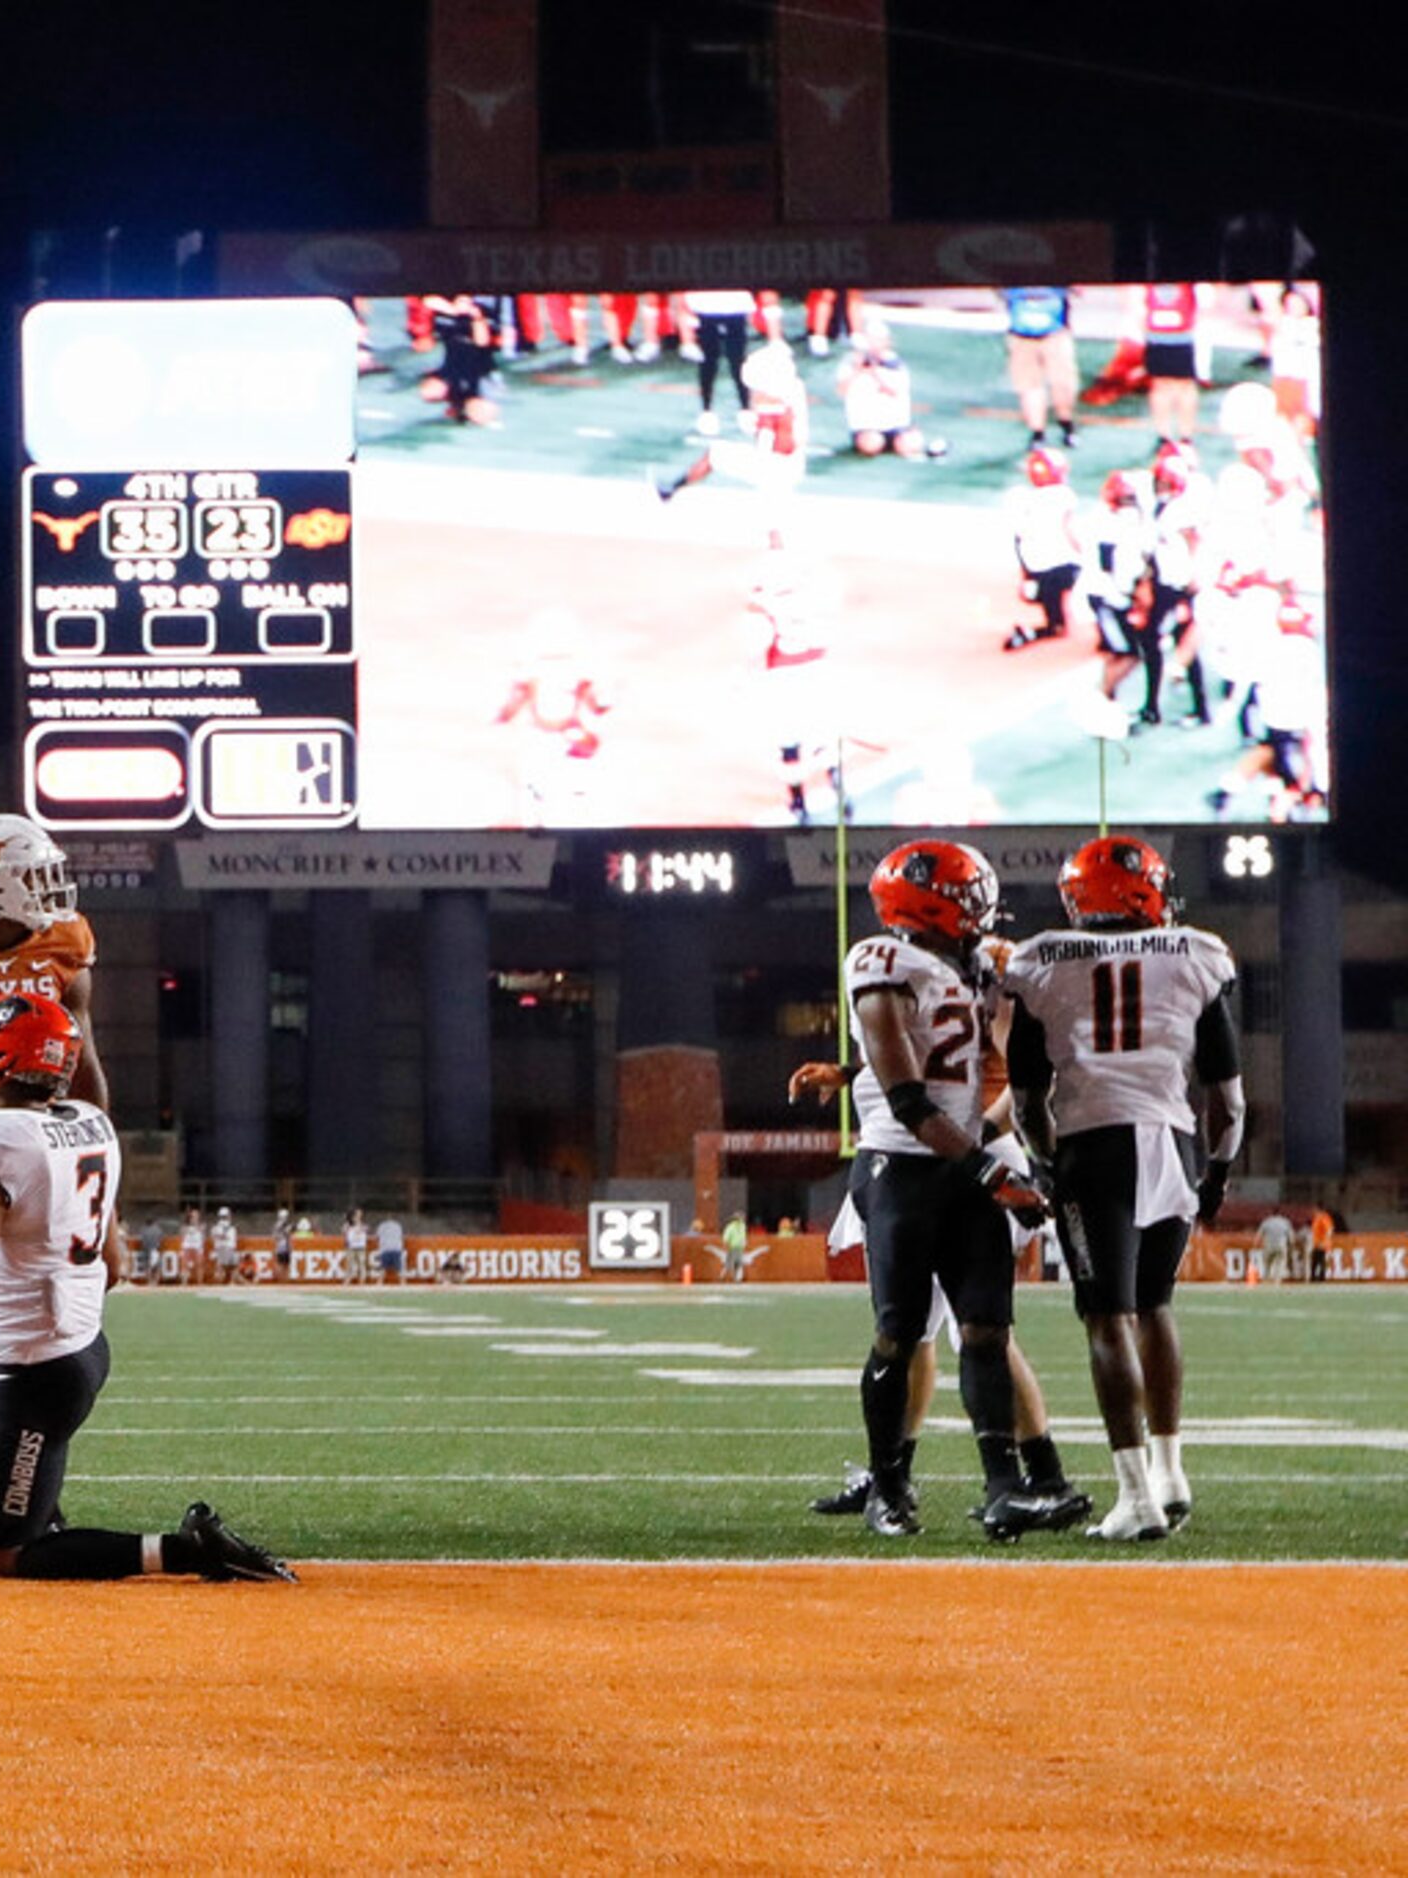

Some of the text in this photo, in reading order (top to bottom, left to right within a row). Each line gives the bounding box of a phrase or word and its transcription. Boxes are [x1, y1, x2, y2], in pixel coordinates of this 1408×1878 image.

[460, 239, 869, 285] TEXAS LONGHORNS
[112, 508, 177, 551] 35
[206, 508, 270, 551] 23
[209, 852, 523, 874] MONCRIEF COMPLEX
[853, 943, 898, 975] 24
[1093, 960, 1143, 1054] 11
[764, 1132, 830, 1152] JAMAIL
[68, 1151, 108, 1266] 3
[599, 1209, 660, 1260] 25
[289, 1250, 384, 1279] TEXS
